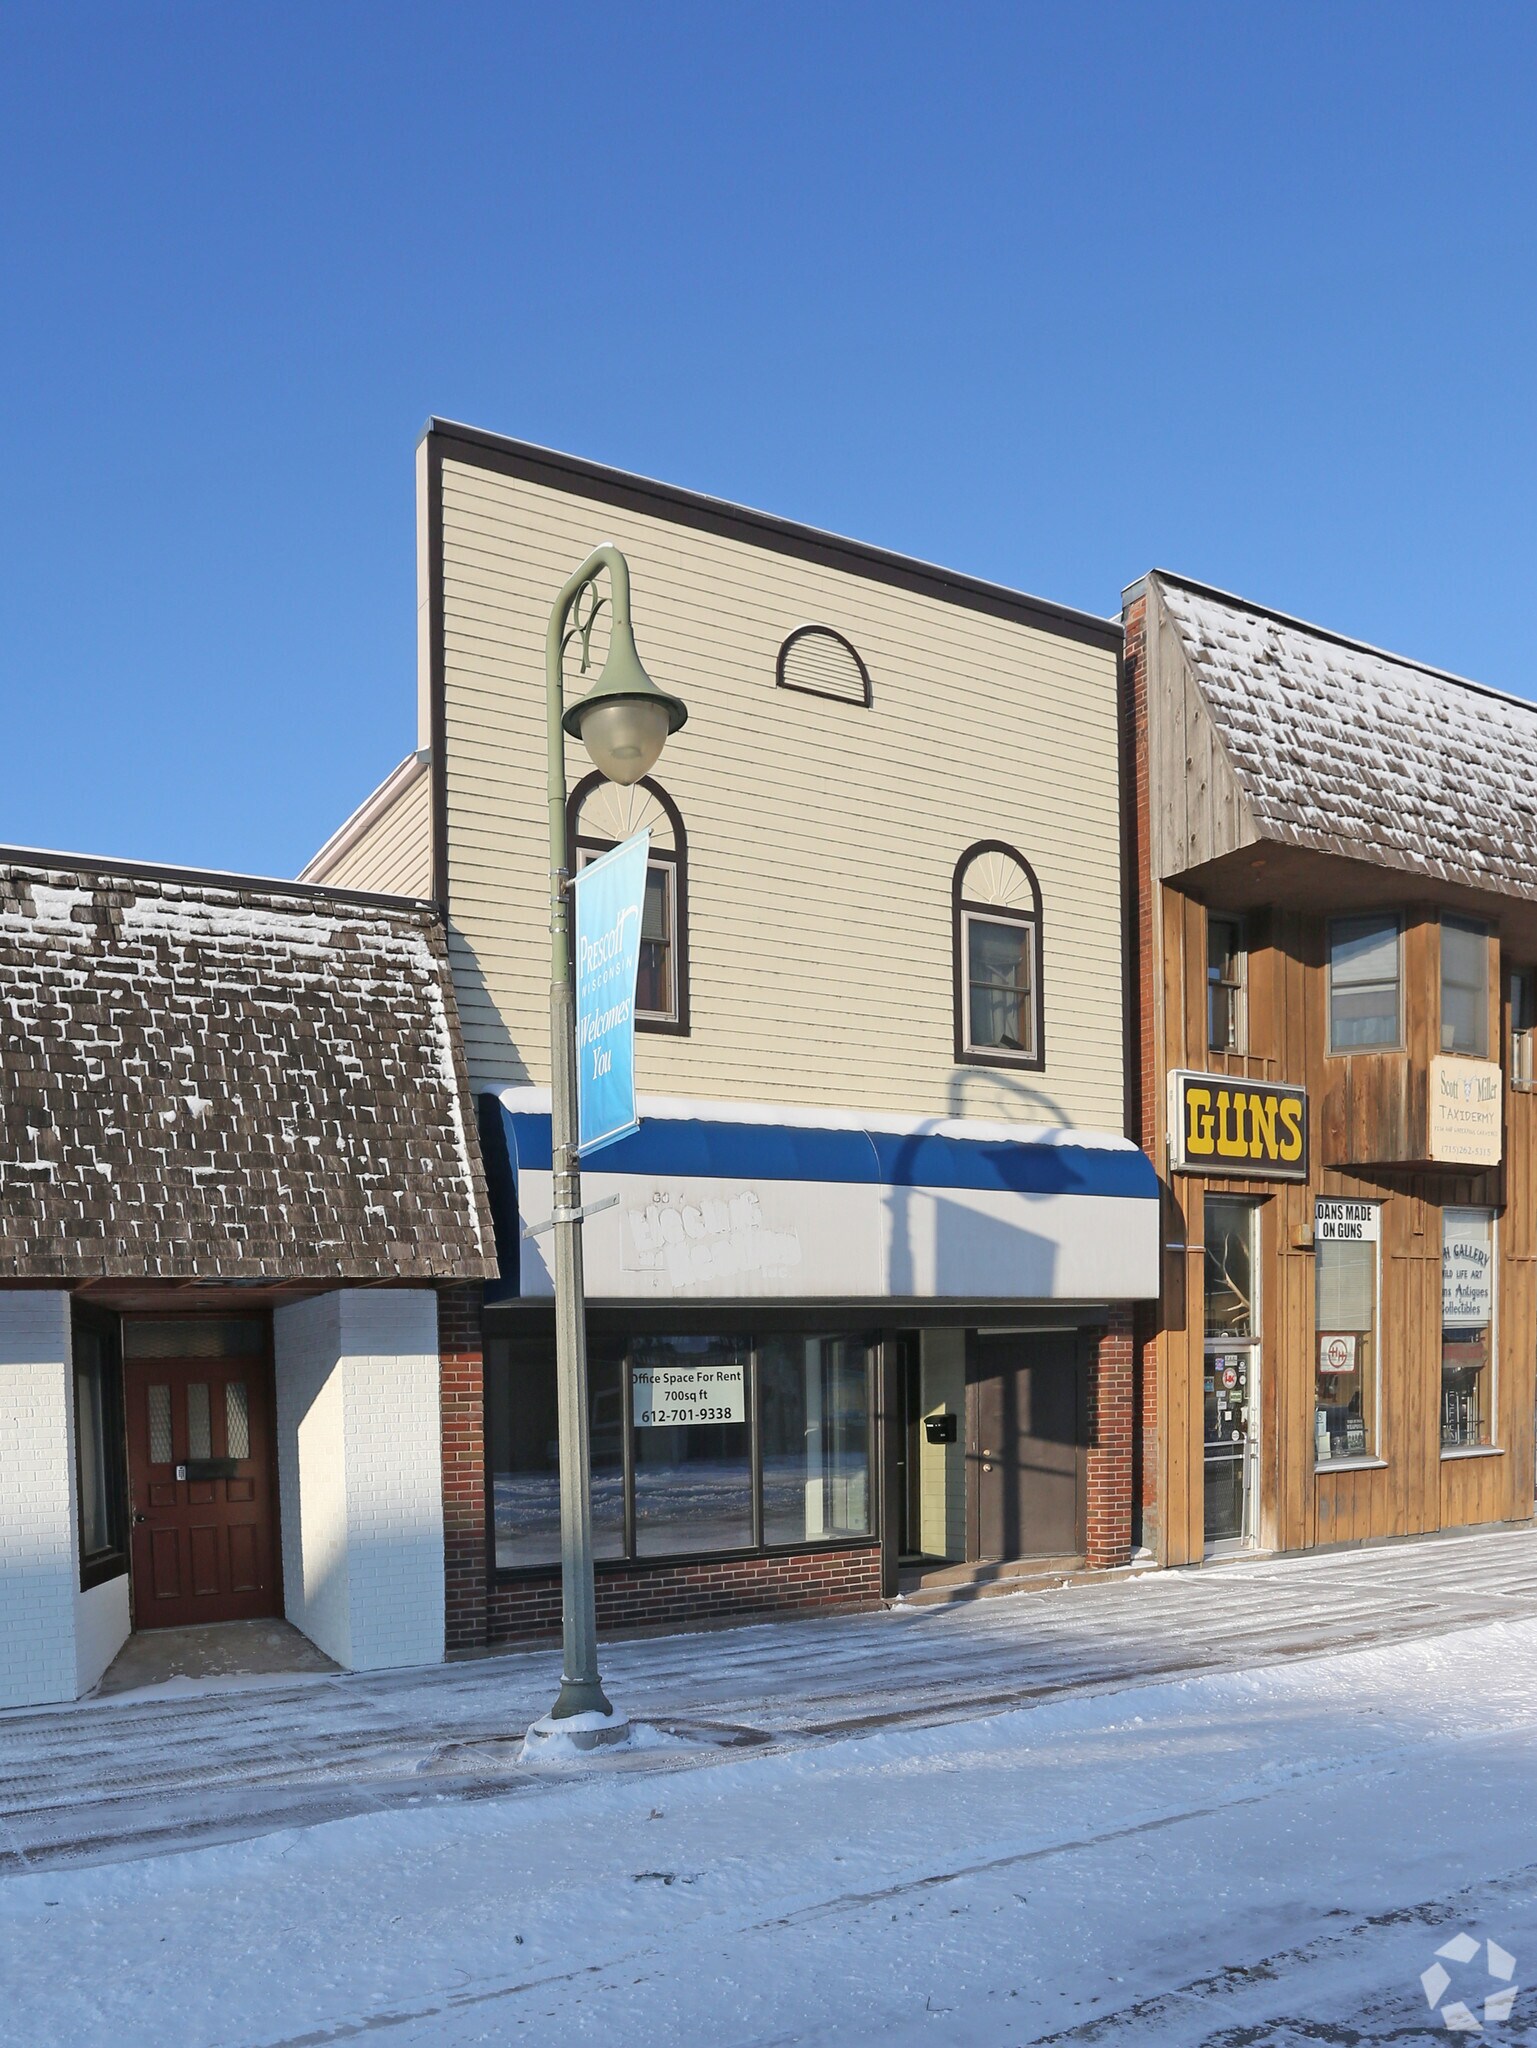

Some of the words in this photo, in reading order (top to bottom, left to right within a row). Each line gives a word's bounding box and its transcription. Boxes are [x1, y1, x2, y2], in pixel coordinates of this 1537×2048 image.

[581, 954, 633, 998] WISCONSIN
[580, 997, 631, 1049] Welcomes
[592, 1046, 612, 1081] You
[1440, 1070, 1459, 1099] Scott
[1476, 1076, 1498, 1102] Miller
[1439, 1105, 1495, 1124] TAXIDERMY
[1186, 1088, 1303, 1161] GUNS
[1315, 1203, 1343, 1220] OANS
[1345, 1205, 1372, 1221] MADE
[1322, 1222, 1335, 1238] ON
[1337, 1222, 1363, 1239] GUNS
[1453, 1244, 1490, 1268] GALLERY
[1456, 1269, 1468, 1279] LIFE
[1470, 1269, 1483, 1279] ART
[1455, 1283, 1489, 1302] Antiques
[632, 1372, 661, 1385] Office
[663, 1372, 695, 1386] Space
[696, 1371, 714, 1382] For
[716, 1371, 741, 1382] Rent
[664, 1391, 697, 1403] 700sq
[699, 1389, 708, 1400] ft
[641, 1407, 732, 1423] 612-701-9338
